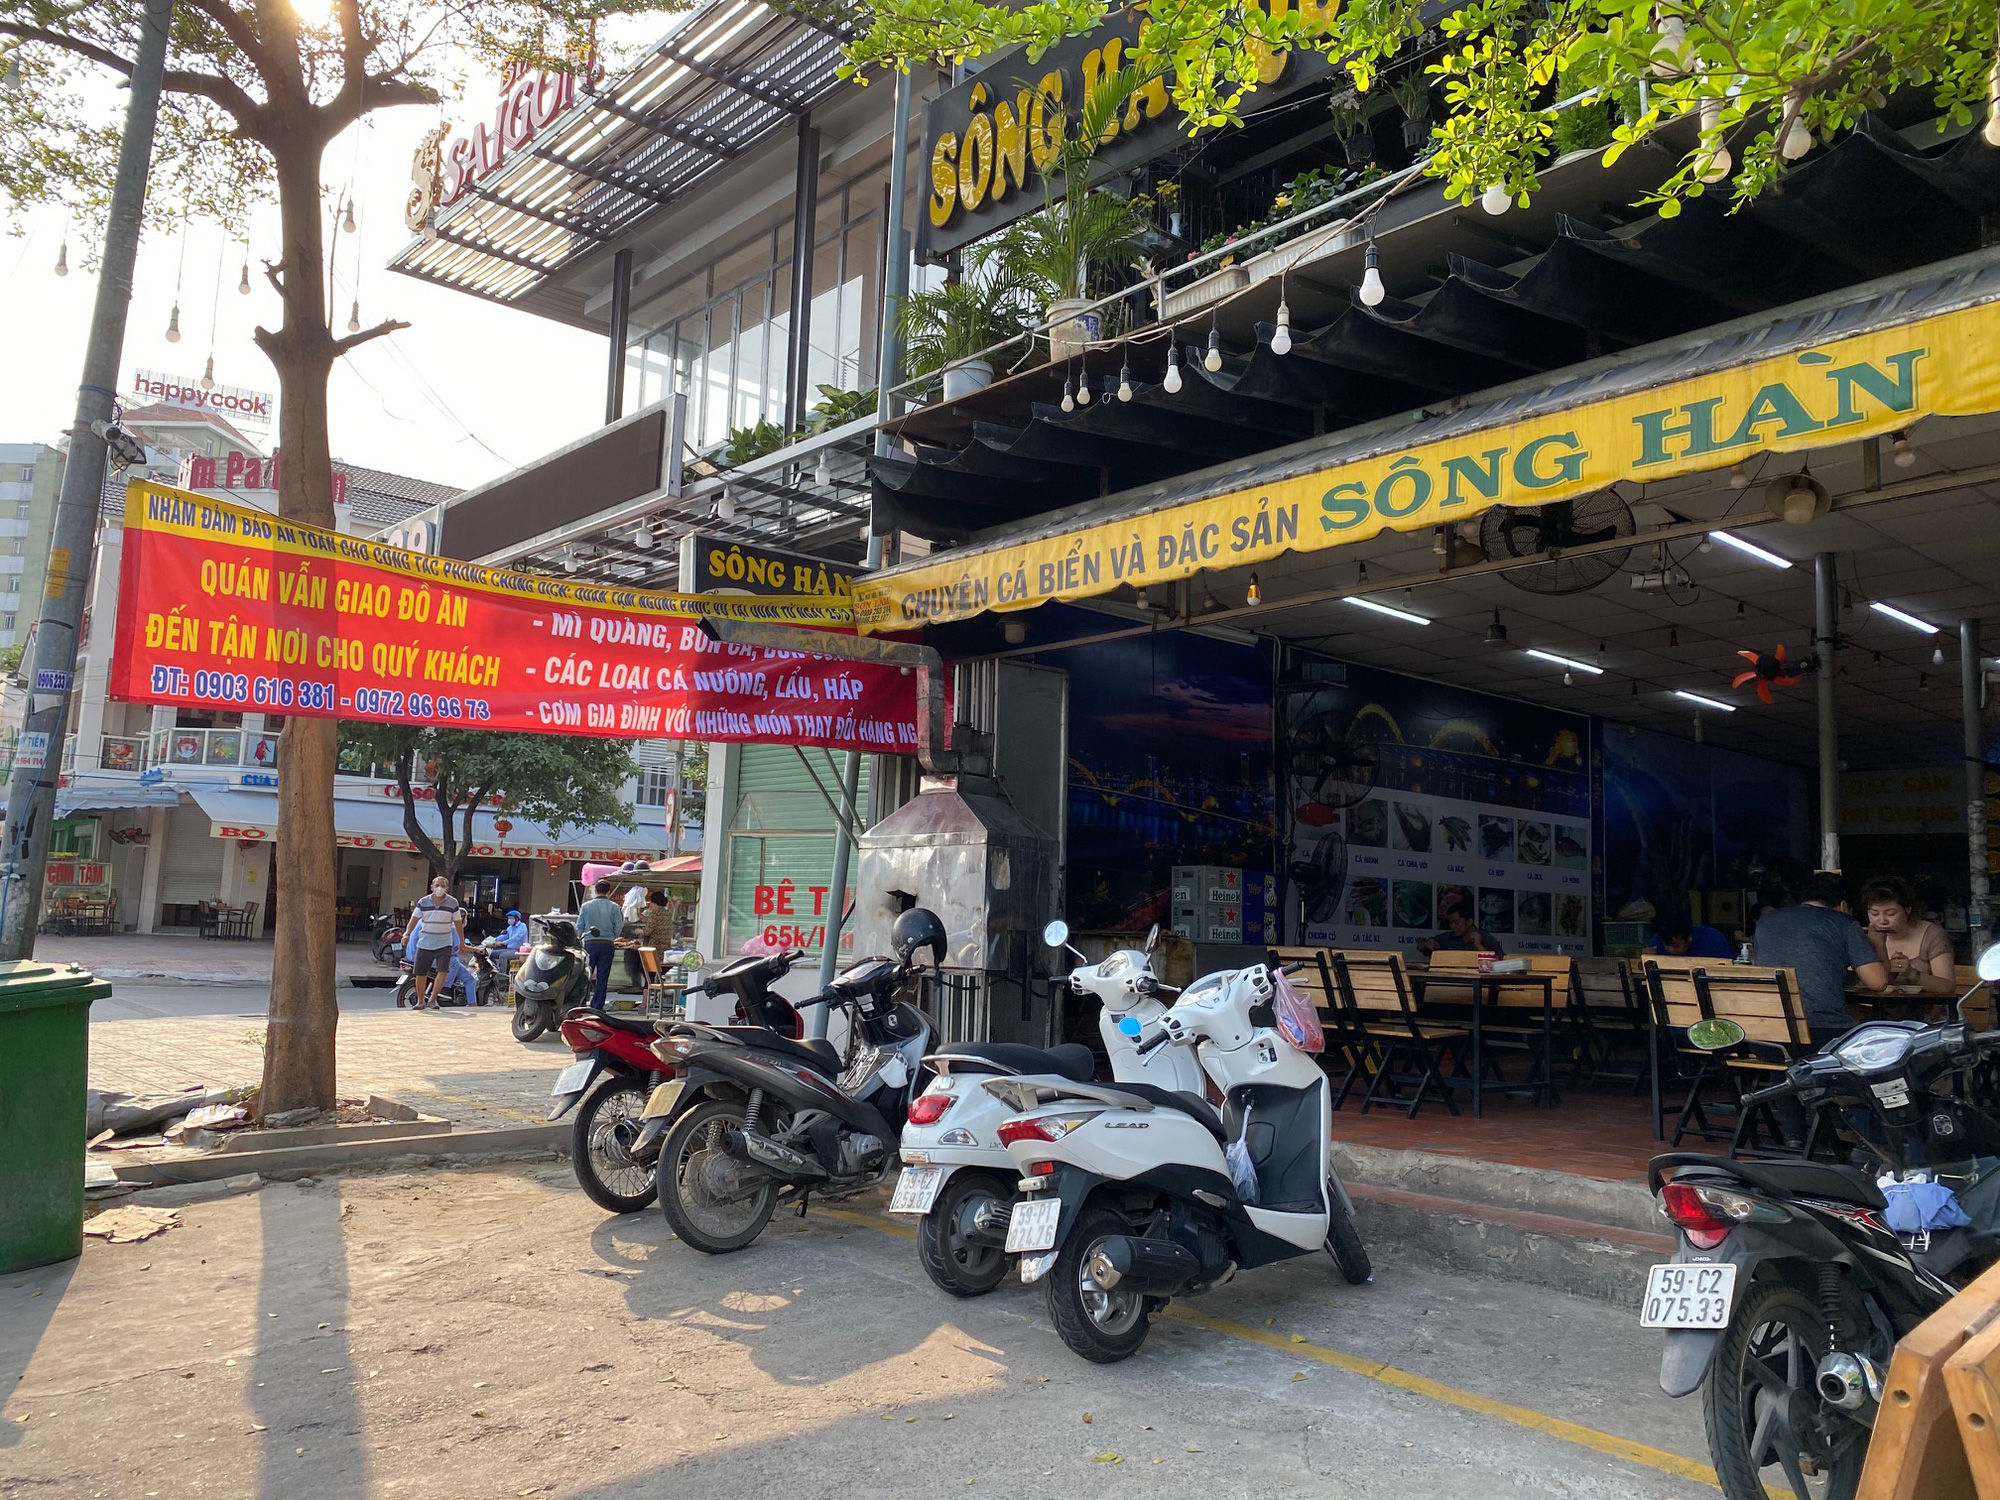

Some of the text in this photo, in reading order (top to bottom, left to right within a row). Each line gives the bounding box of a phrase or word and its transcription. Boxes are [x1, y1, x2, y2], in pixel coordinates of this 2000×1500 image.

[929, 69, 1067, 229] SÔNG
[135, 374, 268, 415] happycook
[901, 347, 1930, 622] CHUYÊN CÁ BIỂN VÀ ĐẶC SẢN SÔNG HÀN
[148, 492, 196, 527] NHẰM
[201, 504, 237, 534] ĐẢM
[242, 514, 272, 539] BẢO
[277, 525, 297, 544] AN
[339, 539, 369, 561] CHO
[709, 545, 852, 596] SÔNG HÀN
[201, 557, 468, 627] QUÁN VẪN GIAO ĐỒ ĂN
[145, 604, 500, 687] ĐẾN TẬN NƠI CHO QUÝ KHÁCH
[551, 610, 582, 638] MÌ
[590, 617, 672, 653] QUẢNG,
[151, 664, 189, 696] ĐT:
[194, 669, 248, 704] 0903
[253, 676, 293, 707] 616
[297, 681, 335, 710] 381
[355, 687, 404, 716] 0972
[408, 692, 433, 718] 96
[437, 696, 461, 722] 96
[465, 699, 491, 720] 73
[544, 652, 593, 686] CÁC
[598, 663, 650, 695] LOẠI
[656, 664, 689, 690] CÁ
[823, 671, 864, 700] HẤP
[538, 700, 581, 726] CƠM
[587, 703, 616, 728] GIA
[620, 700, 661, 731] ĐÌNH
[664, 703, 691, 733] VỚI
[695, 706, 751, 734] NHỮNG
[753, 708, 792, 735] MÓN
[794, 714, 833, 739] THAY
[858, 714, 894, 743] HÀNG
[897, 722, 918, 744] NG
[219, 825, 268, 839] BÒ
[754, 878, 795, 915] BÊ
[1212, 890, 1241, 902] Heinek
[1212, 928, 1241, 940] Heinek
[894, 1191, 933, 1208] 259.87
[1017, 1202, 1052, 1225] 59-P1
[1010, 1226, 1053, 1248] 824.76
[1661, 1269, 1722, 1294] 59-C2
[1648, 1297, 1725, 1323] 075.33
